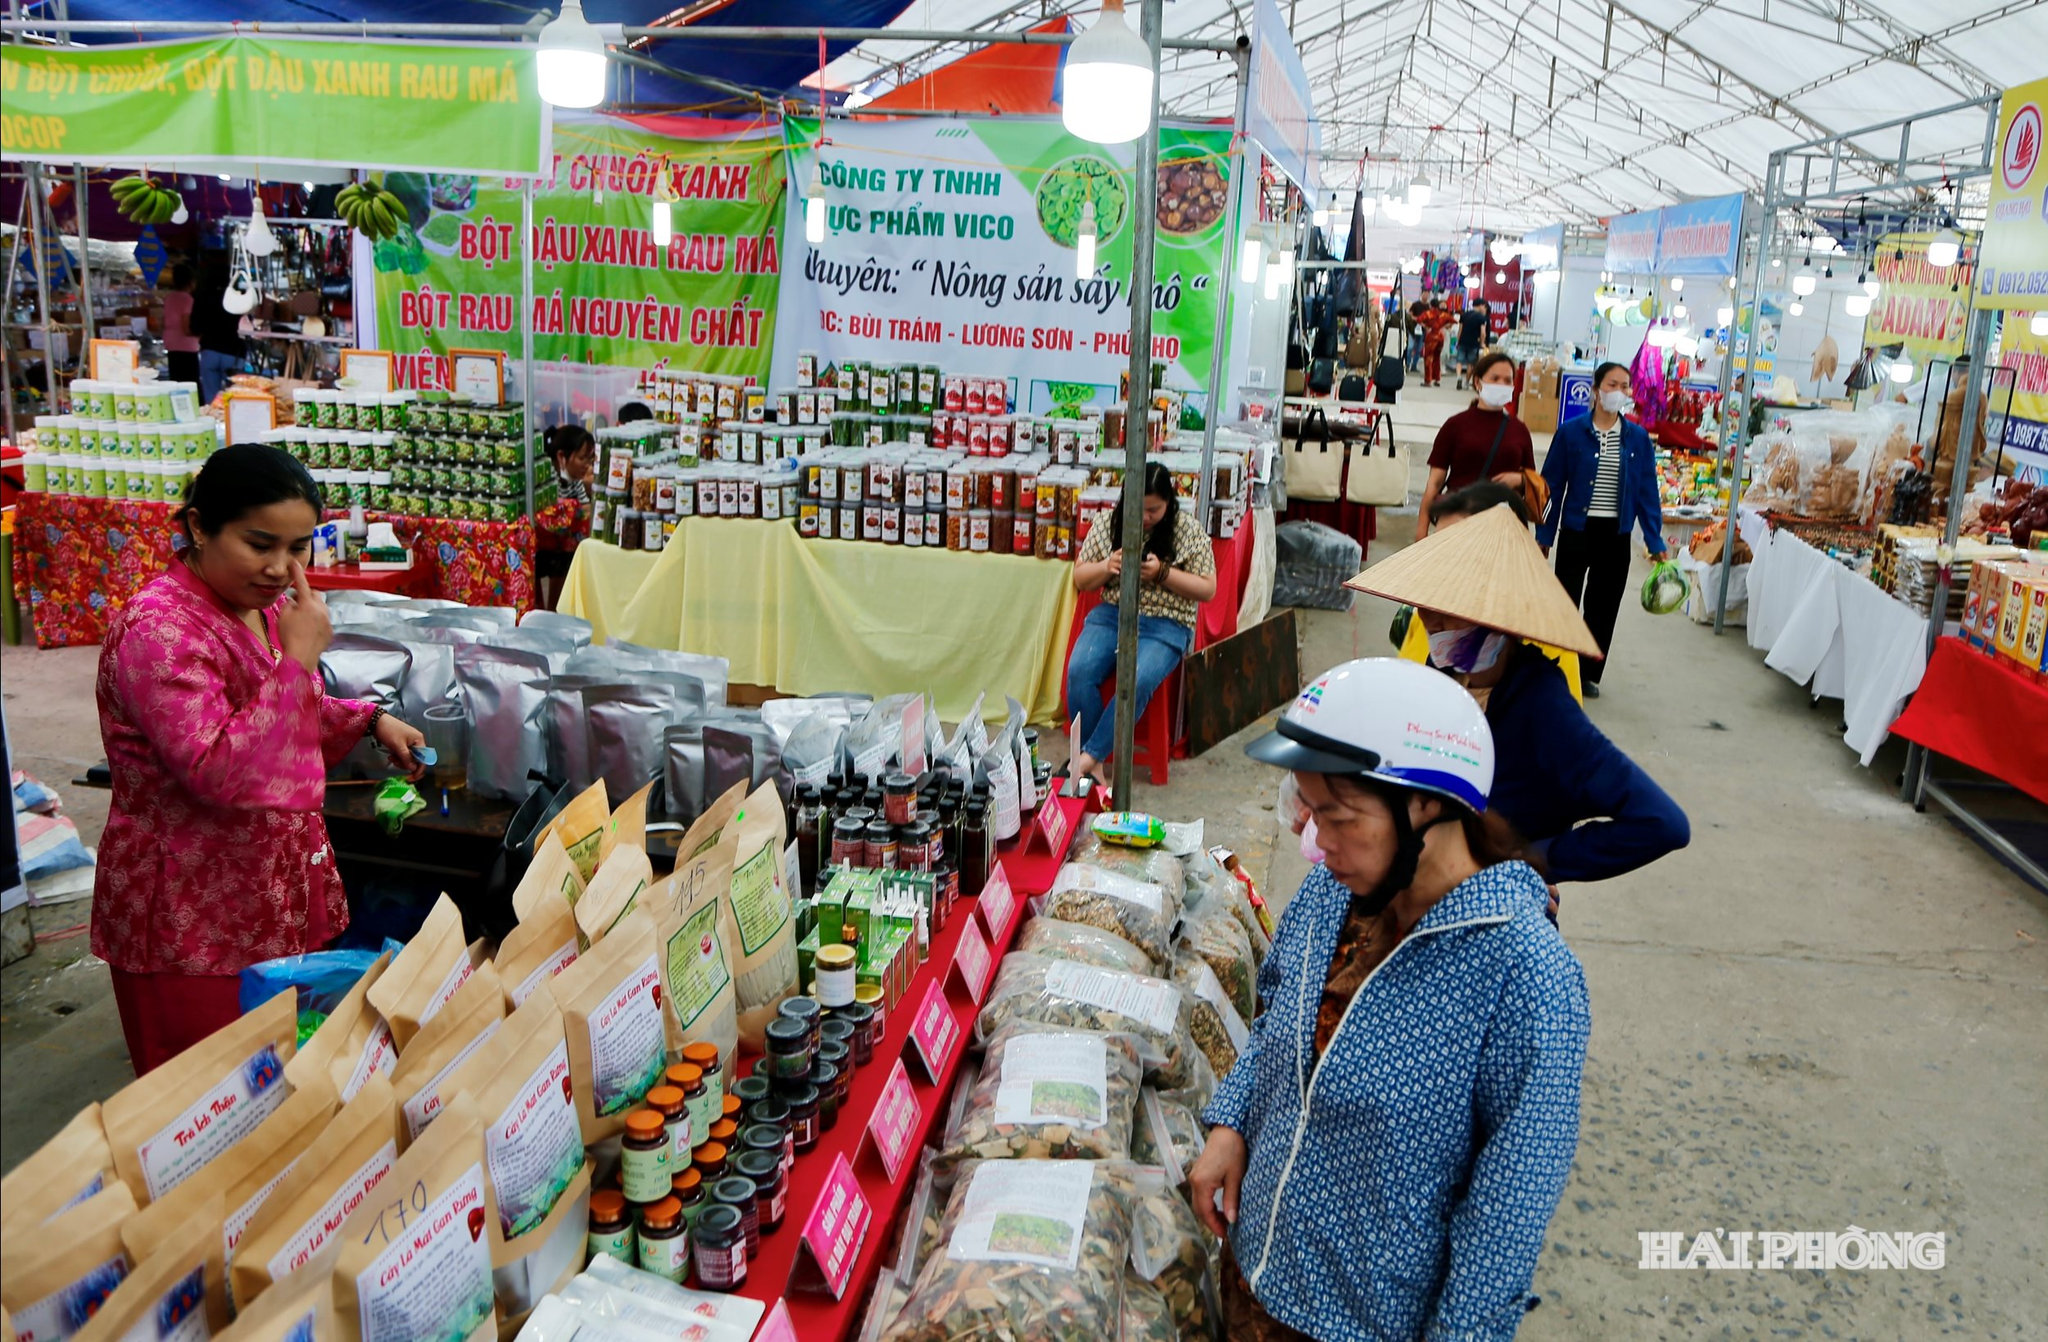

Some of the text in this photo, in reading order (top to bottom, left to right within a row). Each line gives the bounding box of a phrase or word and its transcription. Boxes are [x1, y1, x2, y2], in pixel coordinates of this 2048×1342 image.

[27, 56, 80, 100] BỘT
[184, 49, 237, 98] BỘT
[311, 59, 391, 98] XANH
[400, 63, 459, 101] RAU
[468, 60, 519, 104] MÁ
[671, 163, 750, 200] XANH
[818, 160, 1001, 196] CÔNG TY TNHH
[870, 201, 945, 236] PHẨM
[954, 213, 1015, 240] VICO
[460, 215, 513, 270] BỘT
[581, 225, 658, 269] XANH
[667, 234, 726, 273] RAU
[734, 227, 778, 274] MÁ
[931, 260, 1008, 308] Nông
[1013, 263, 1063, 302] sản
[401, 284, 451, 337] BỘT
[459, 294, 513, 333] RAU
[569, 295, 681, 343] NGUYÊN
[689, 294, 764, 348] CHẤT
[849, 313, 882, 339] BÙI
[888, 316, 942, 343] TRÁM
[962, 322, 1025, 348] LƯƠNG
[1031, 327, 1074, 351] SƠN
[173, 1129, 196, 1148] Trà
[210, 1093, 237, 1117] Thận
[343, 1191, 364, 1216] Gan
[363, 1180, 428, 1246] 170
[432, 1211, 453, 1235] Gan
